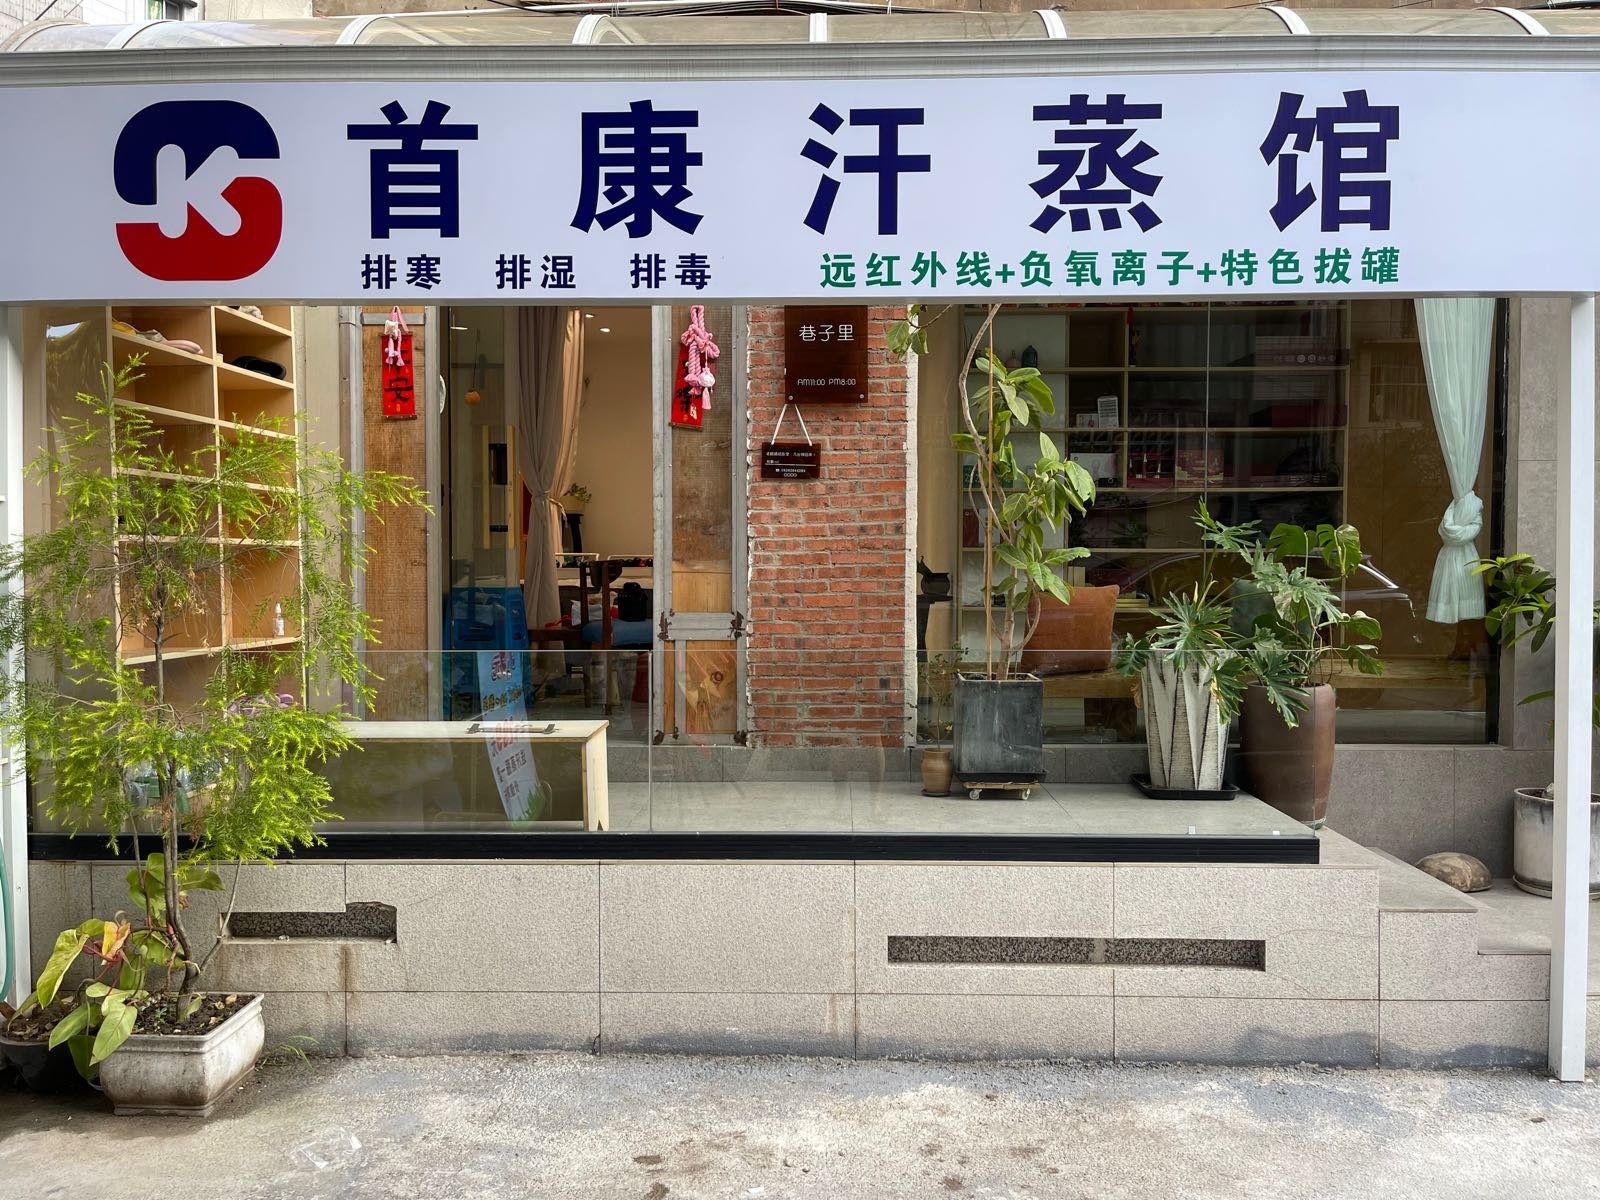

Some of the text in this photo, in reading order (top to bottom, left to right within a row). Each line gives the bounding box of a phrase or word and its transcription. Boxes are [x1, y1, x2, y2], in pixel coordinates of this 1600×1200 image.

[346, 89, 1400, 240] 首康汗蒸馆
[361, 253, 712, 290] 排寒 排湿 排毒
[819, 246, 1400, 289] 远红外线+负氧离子+特色拔罐
[798, 324, 855, 342] 巷子里
